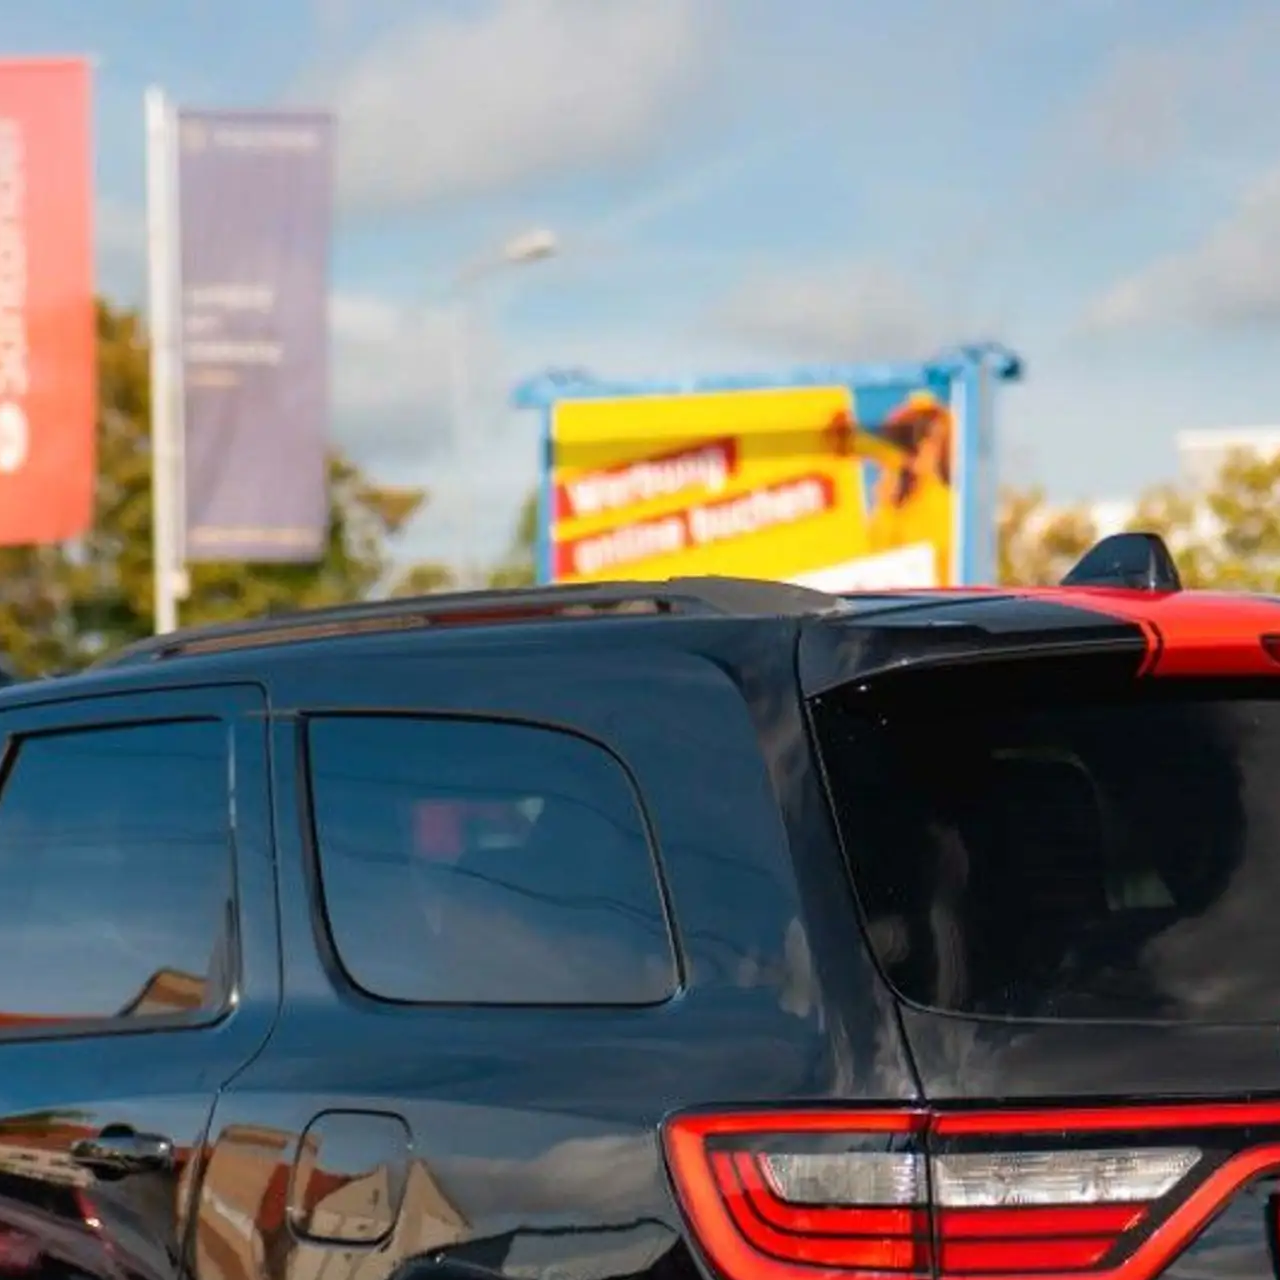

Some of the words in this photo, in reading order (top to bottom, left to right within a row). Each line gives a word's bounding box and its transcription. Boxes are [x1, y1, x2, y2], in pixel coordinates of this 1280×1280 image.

[568, 445, 728, 516] Werbung
[574, 513, 683, 575] online
[689, 478, 826, 543] buchen
